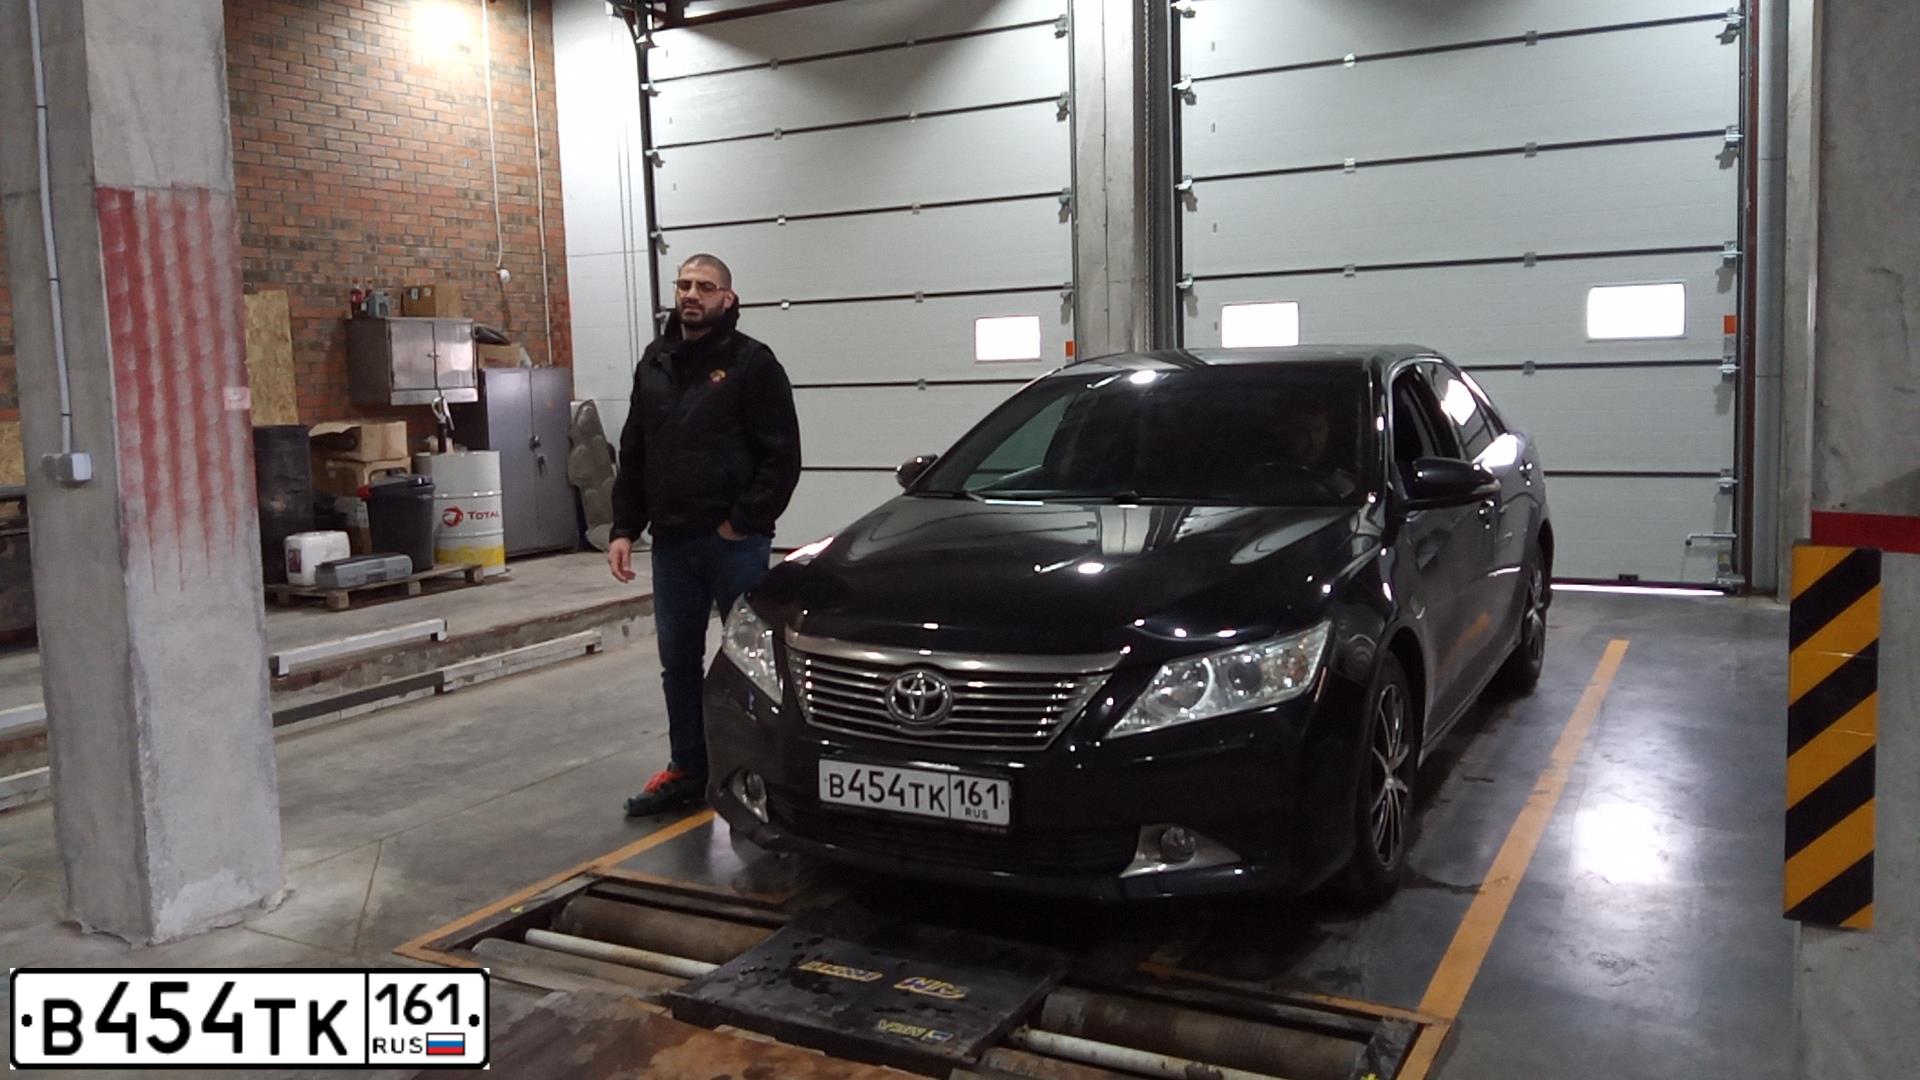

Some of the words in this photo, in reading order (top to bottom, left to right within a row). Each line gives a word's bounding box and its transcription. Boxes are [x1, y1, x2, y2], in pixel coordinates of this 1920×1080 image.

[466, 511, 499, 521] TOTAL
[953, 779, 999, 810] 161
[964, 807, 989, 820] RUS
